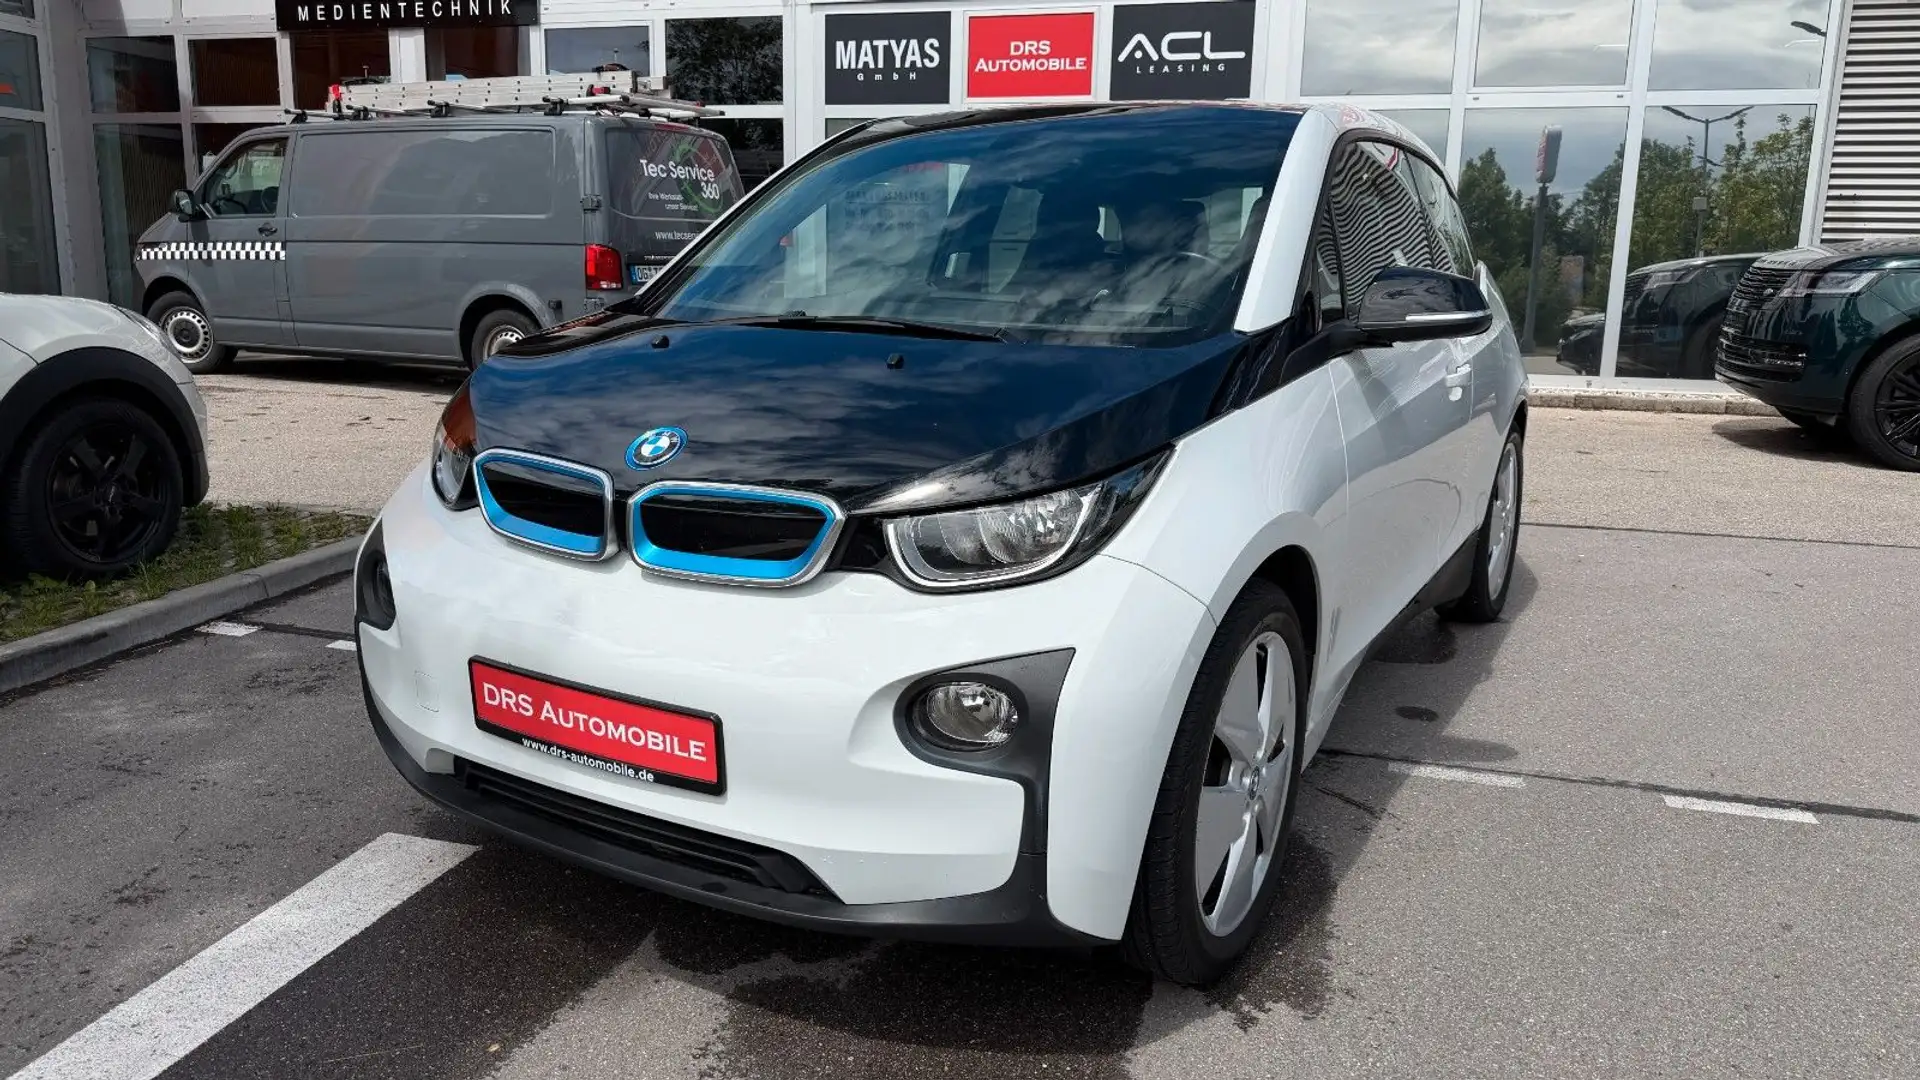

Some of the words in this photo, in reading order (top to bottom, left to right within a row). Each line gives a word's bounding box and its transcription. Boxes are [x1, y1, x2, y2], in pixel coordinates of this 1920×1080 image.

[297, 0, 512, 22] MEDIENTECHNIK
[835, 38, 940, 70] MATYAS
[1009, 40, 1052, 56] DRS
[1117, 31, 1246, 62] ACL
[974, 57, 1088, 72] AUTOMOBILE
[1136, 63, 1226, 74] LEASING
[640, 159, 667, 178] Tec
[668, 161, 716, 182] Service
[700, 182, 721, 200] 360
[483, 682, 533, 717] DRS
[540, 701, 707, 762] AUTOMOBILE
[522, 737, 655, 783] www.drs-automobile.de
